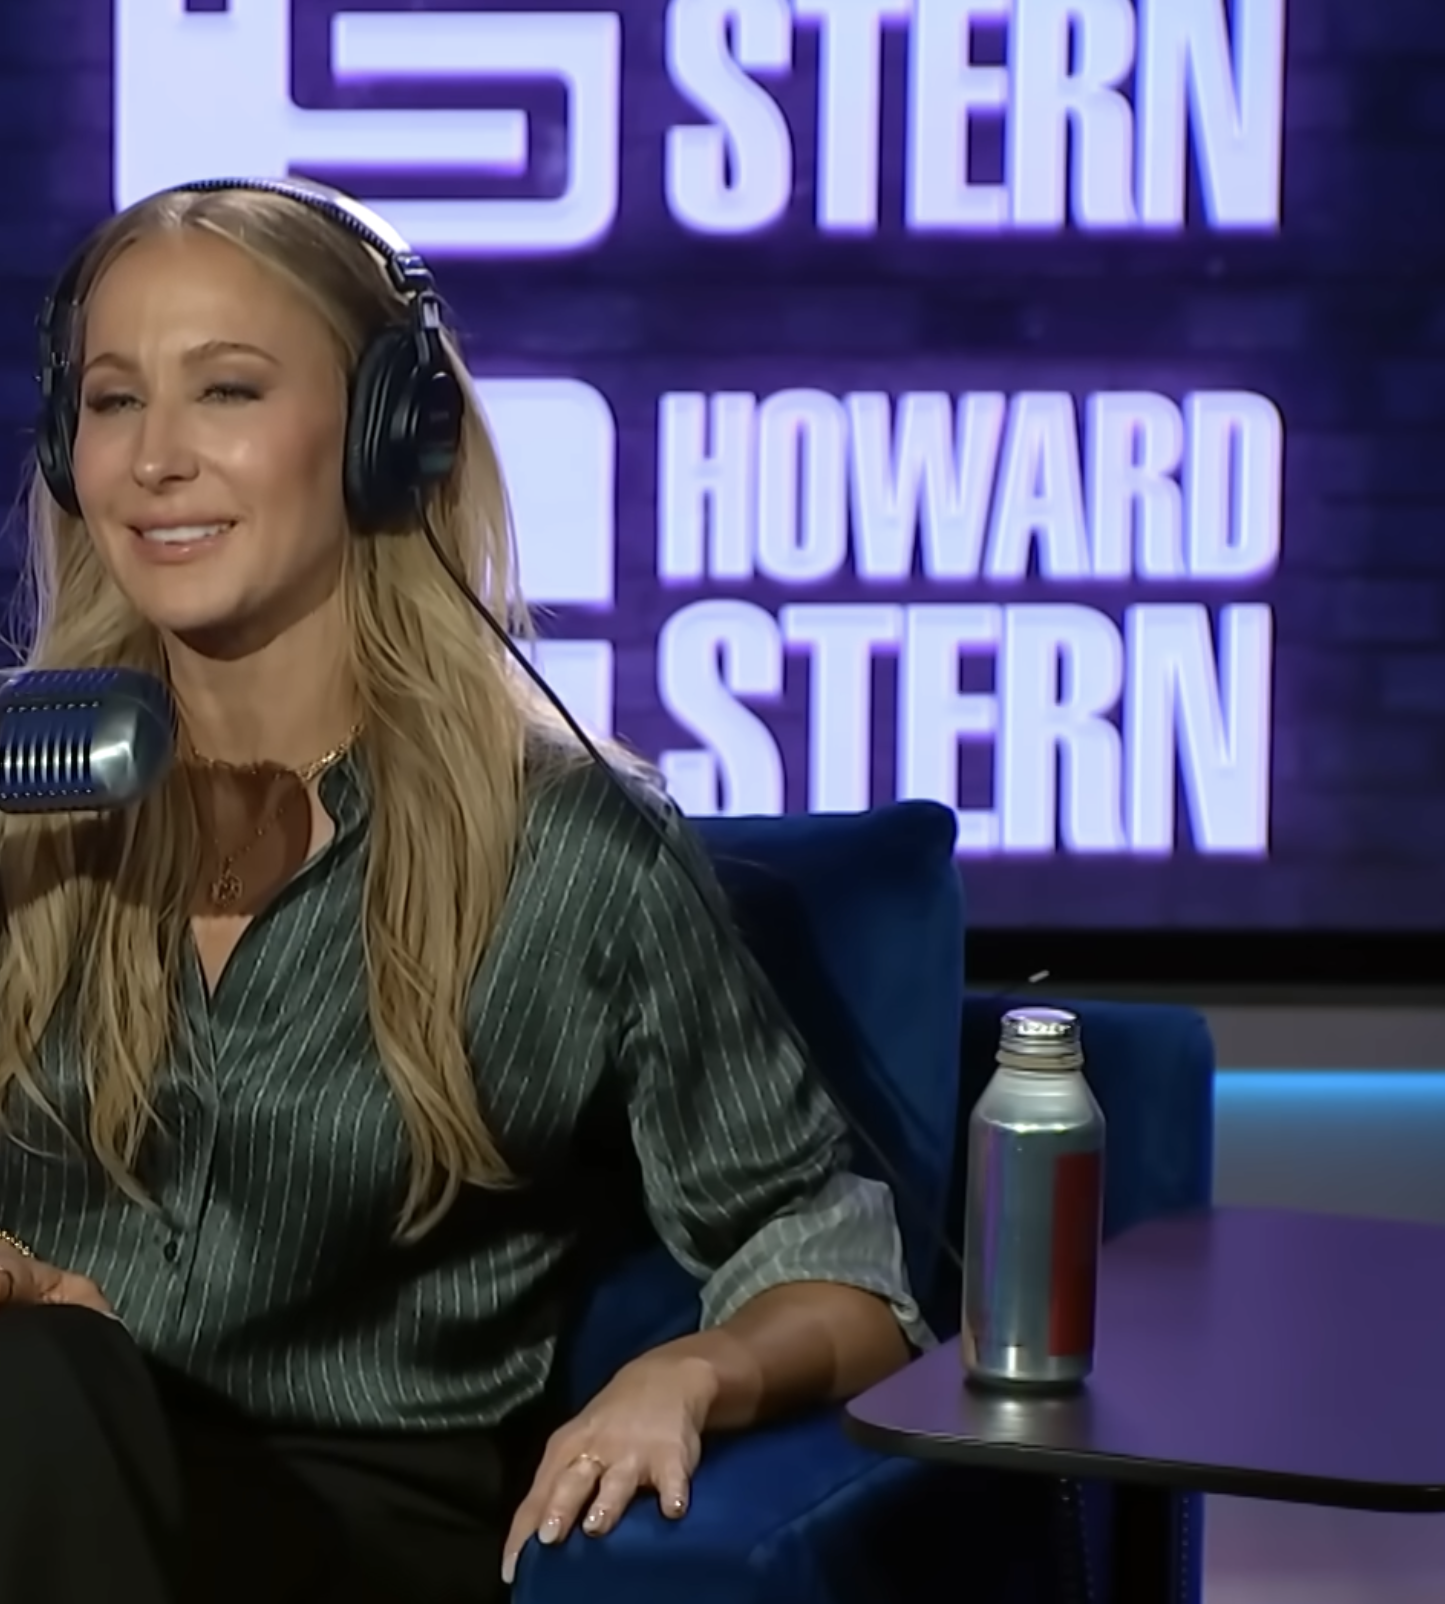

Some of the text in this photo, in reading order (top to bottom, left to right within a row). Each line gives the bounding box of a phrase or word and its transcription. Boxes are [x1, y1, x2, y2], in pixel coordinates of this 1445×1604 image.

[665, 0, 1284, 233] STERN
[658, 387, 1283, 583] HOWARD
[658, 598, 1273, 855] STERN
